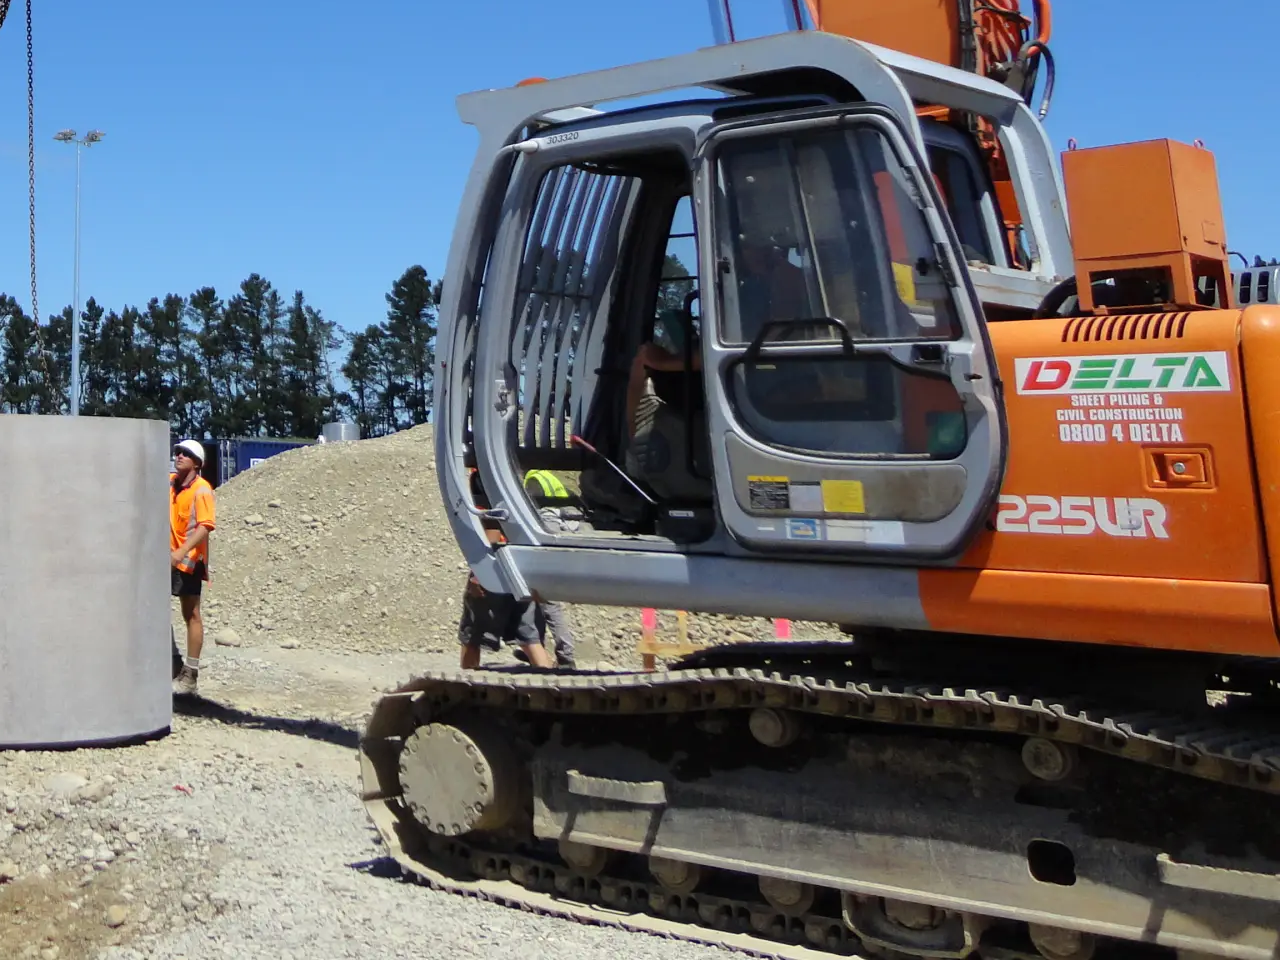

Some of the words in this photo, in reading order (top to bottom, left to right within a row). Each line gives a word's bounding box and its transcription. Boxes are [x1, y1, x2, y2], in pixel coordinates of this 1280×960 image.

[547, 131, 579, 144] 303320
[1021, 356, 1222, 390] DELTA
[1071, 394, 1106, 407] SHEET
[1109, 393, 1150, 406] PILING
[1153, 393, 1163, 405] &
[1056, 409, 1086, 421] CIVIL
[1089, 408, 1183, 421] CONSTRUCTION
[1060, 424, 1106, 442] 0800
[1111, 424, 1124, 442] 4
[1129, 423, 1184, 442] DELTA
